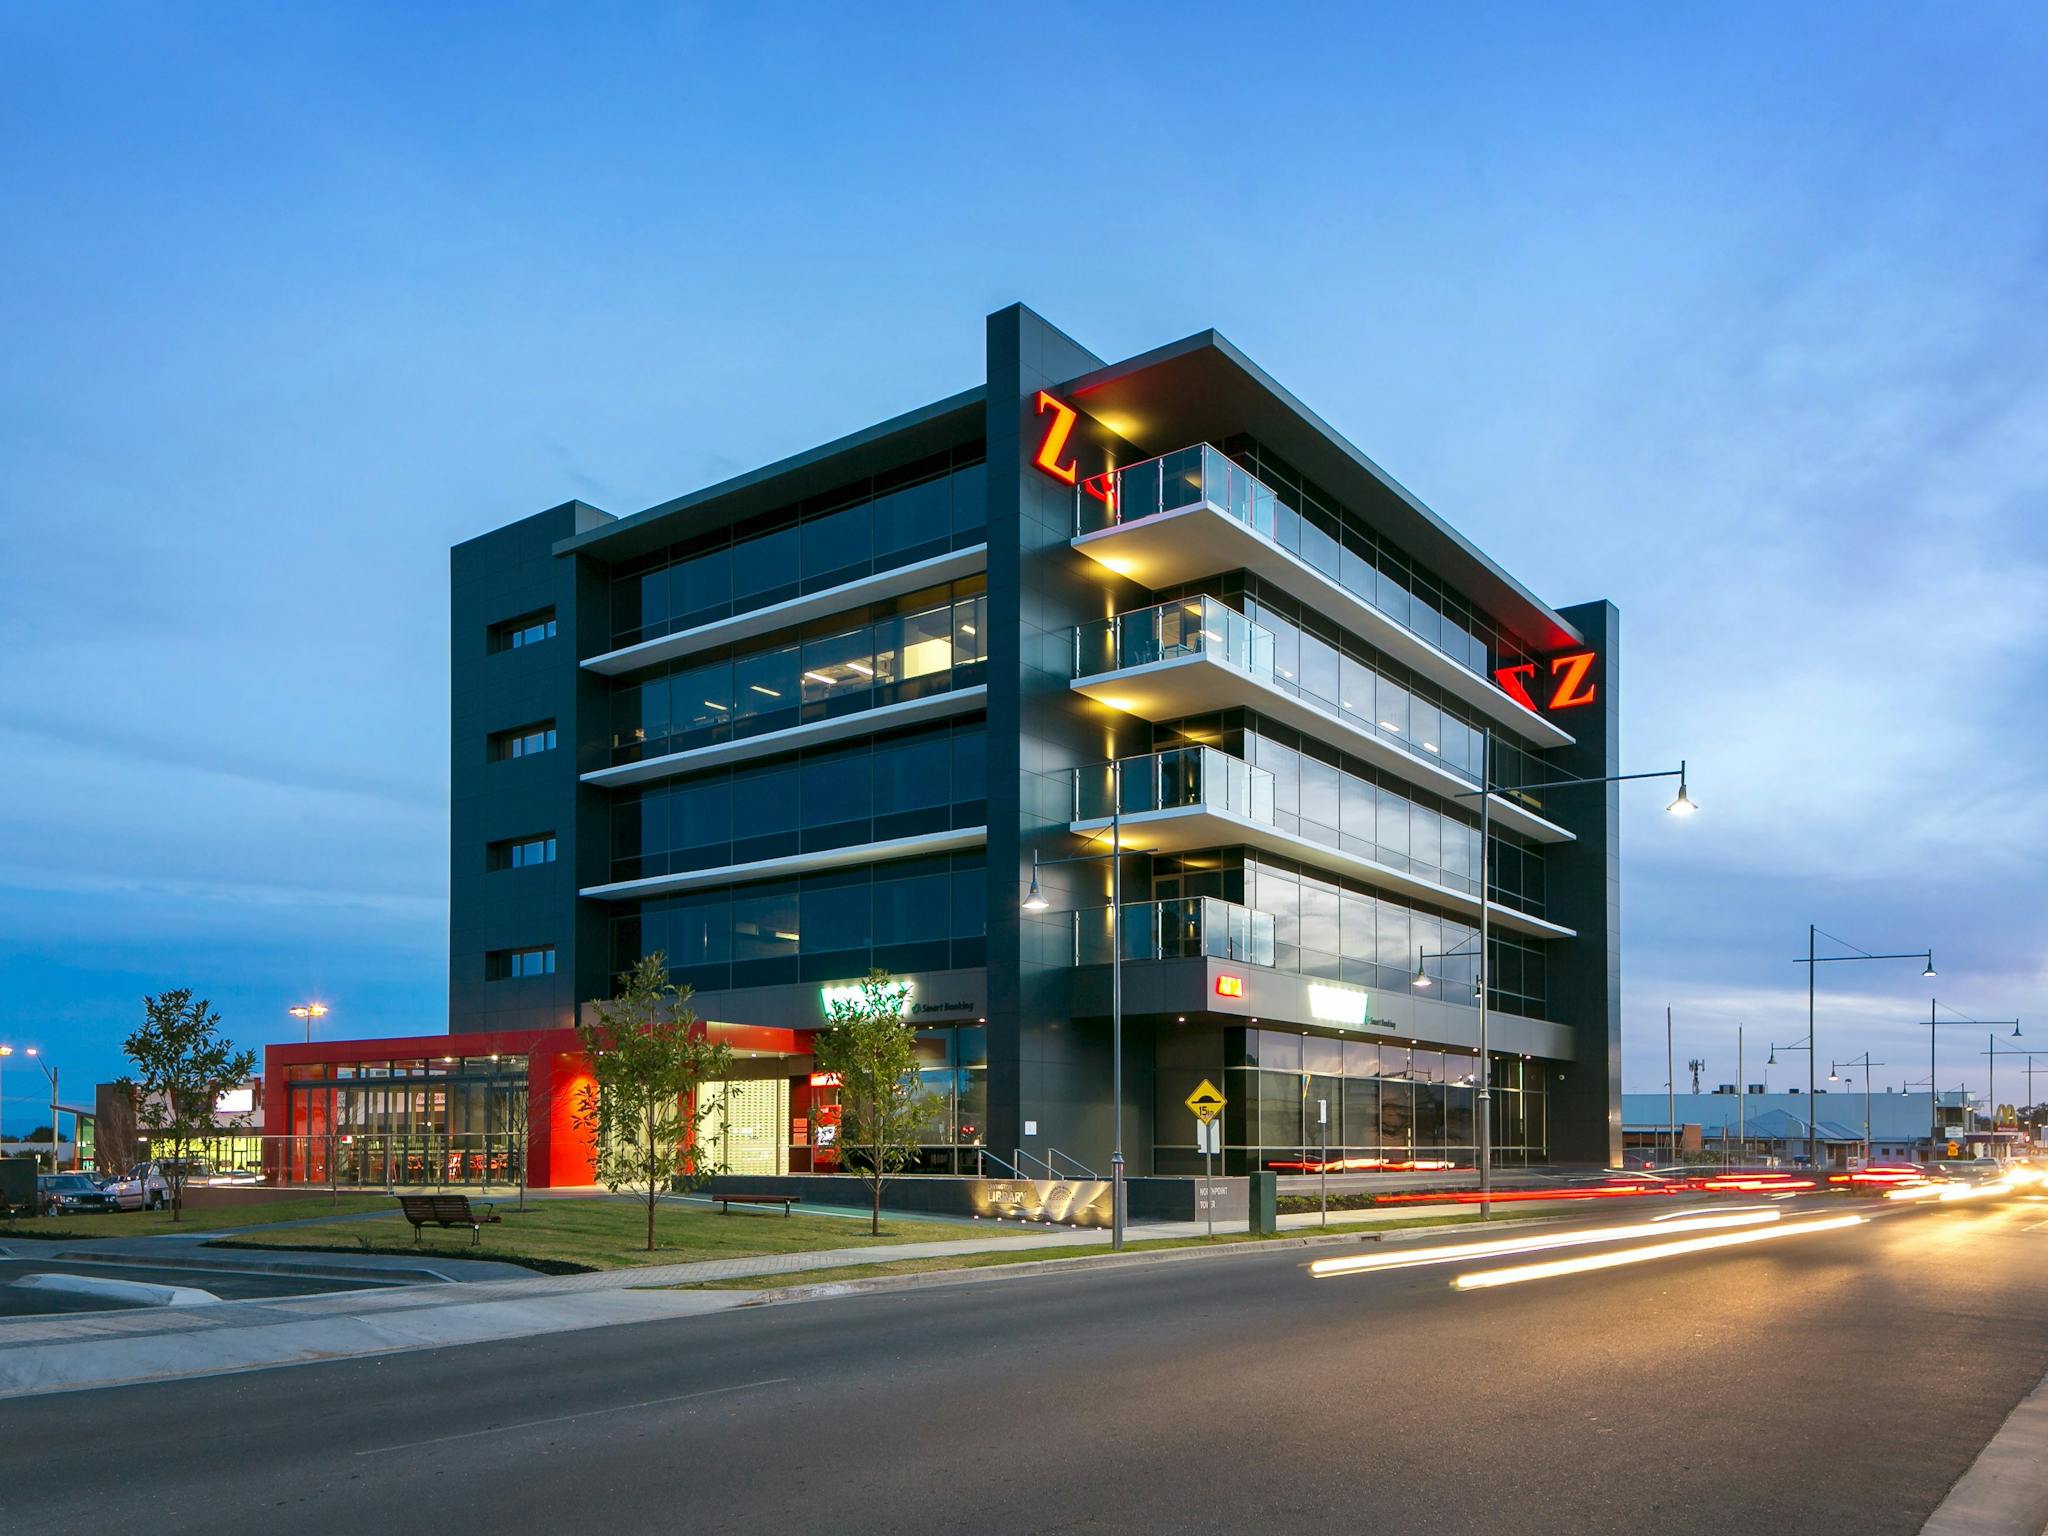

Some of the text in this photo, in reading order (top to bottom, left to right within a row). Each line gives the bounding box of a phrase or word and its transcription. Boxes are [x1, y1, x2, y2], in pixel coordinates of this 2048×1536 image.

[1549, 652, 1595, 710] Z
[988, 1191, 1027, 1203] LIBRARY
[1200, 1187, 1228, 1196] NORHPOINT
